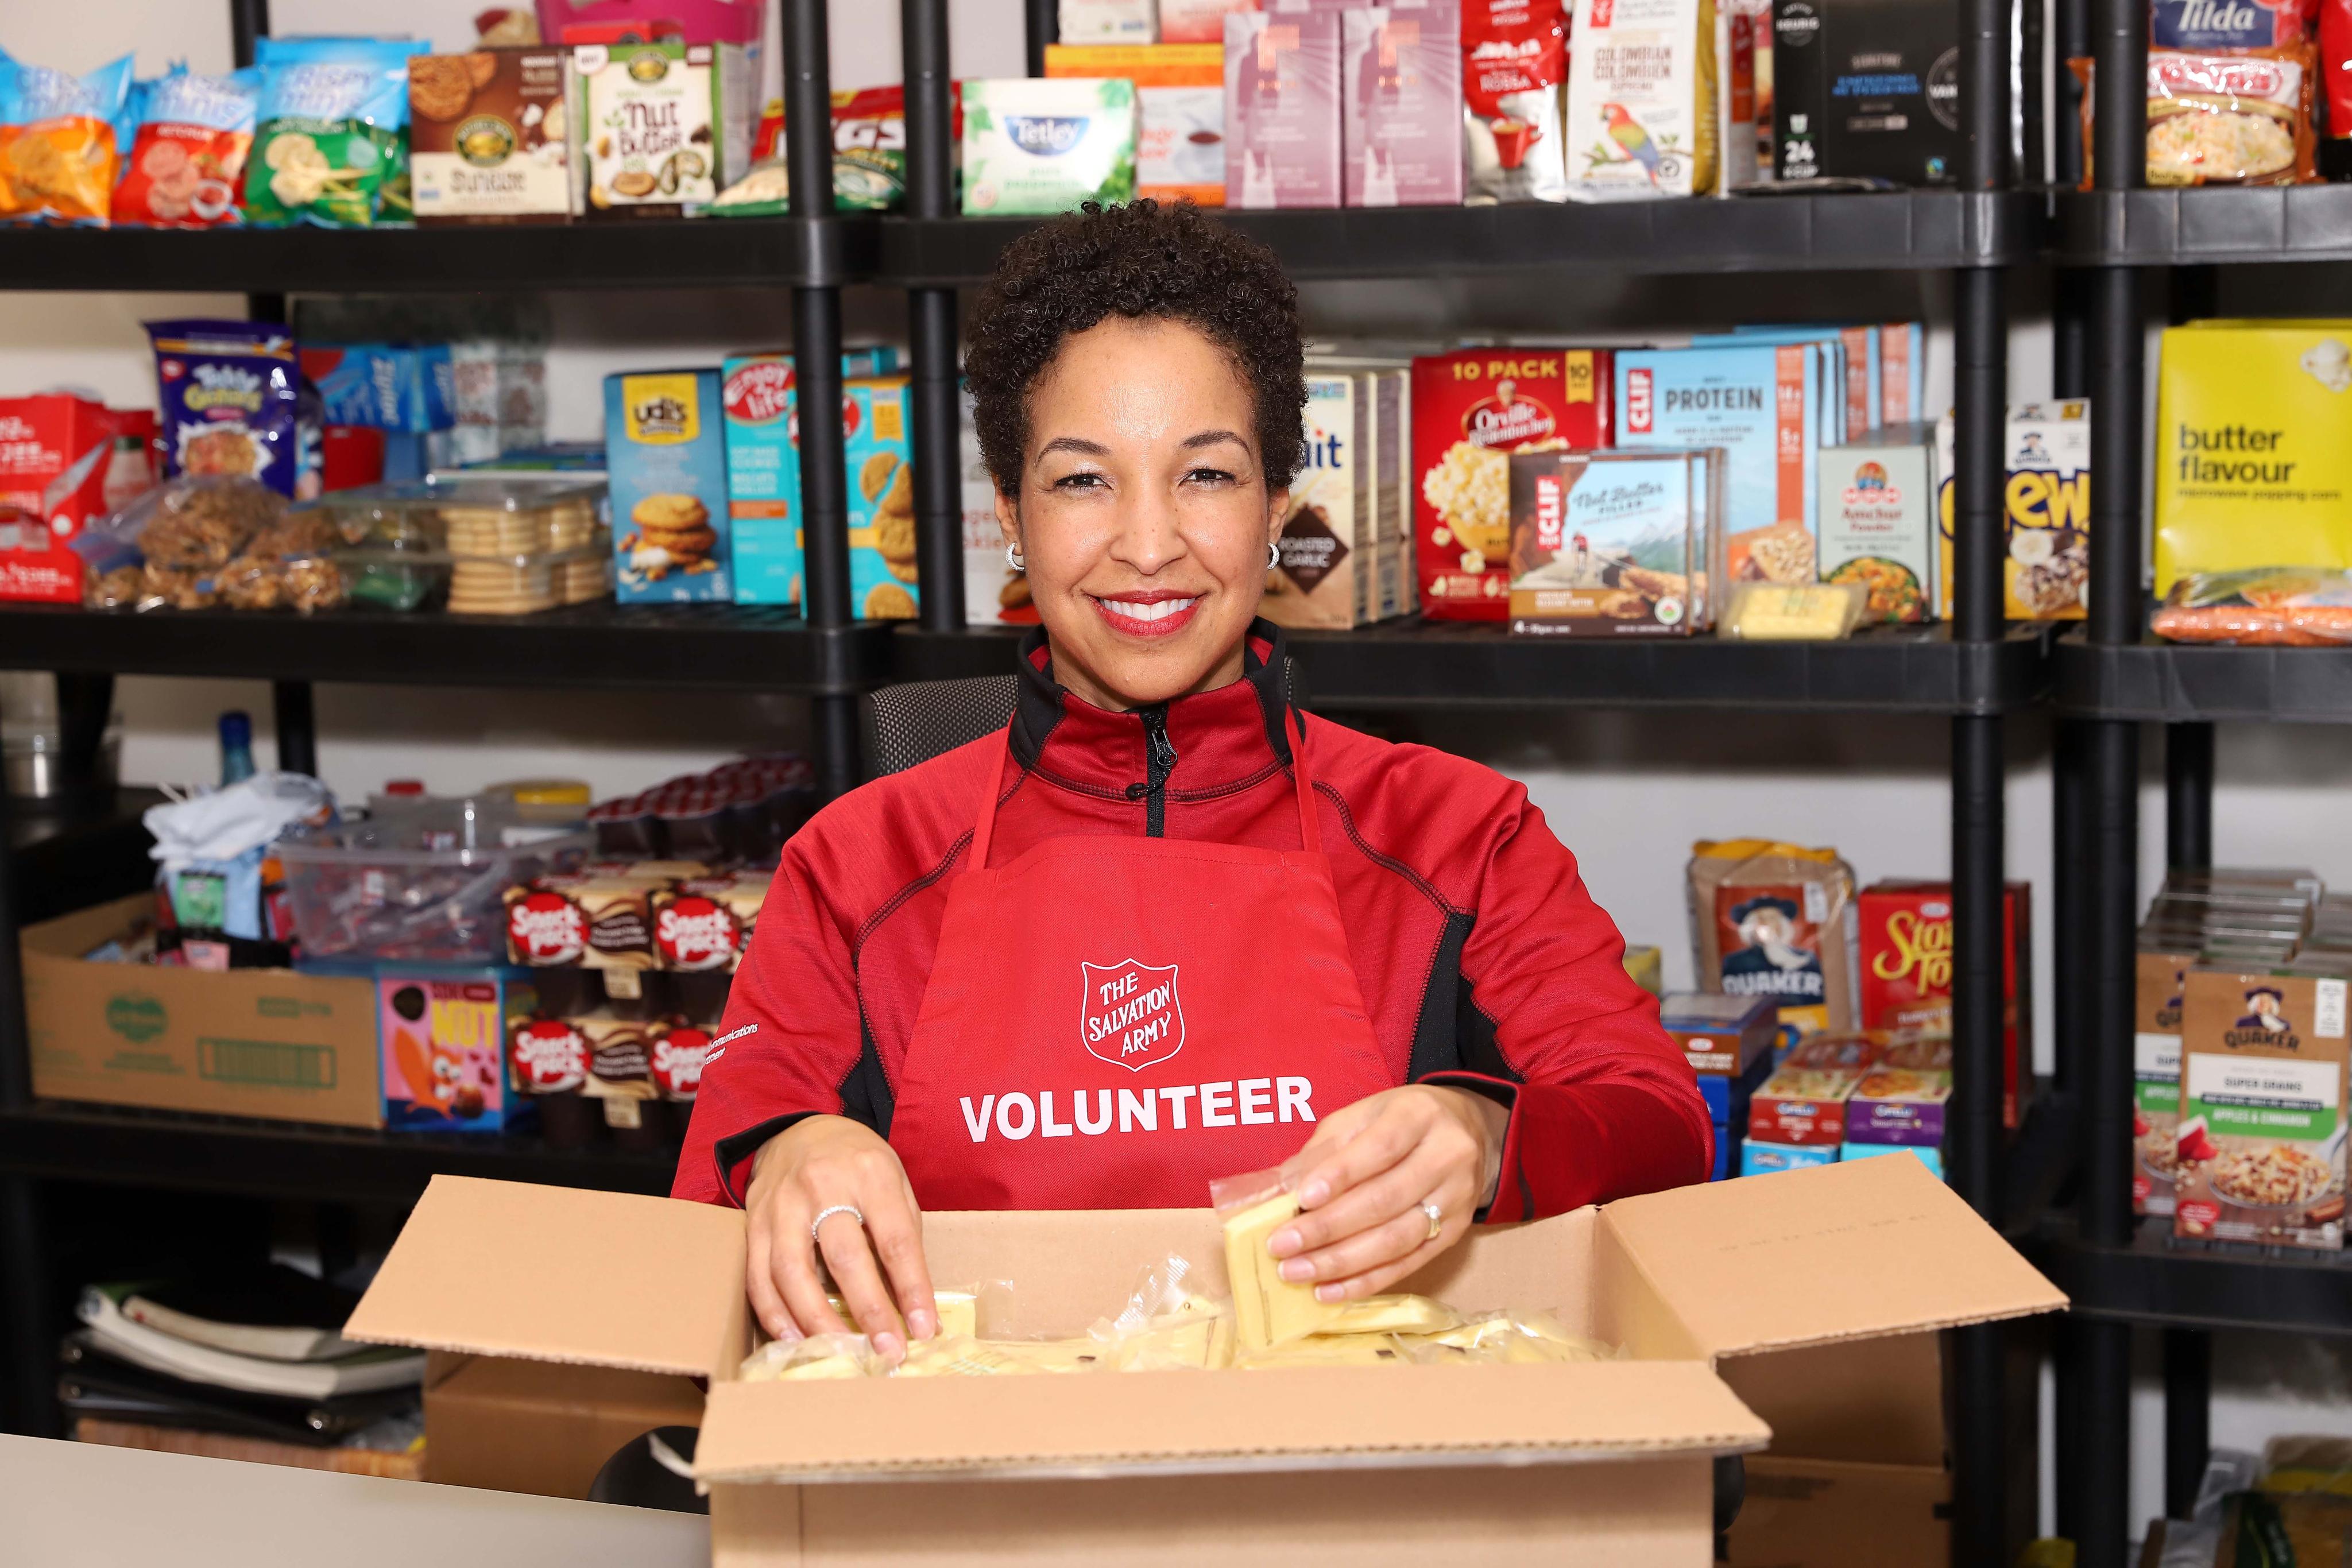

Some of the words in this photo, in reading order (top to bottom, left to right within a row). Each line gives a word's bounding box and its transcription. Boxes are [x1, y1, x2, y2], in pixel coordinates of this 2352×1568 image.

[1012, 118, 1081, 150] Tetley
[1785, 140, 1815, 163] 24
[1453, 361, 1481, 380] 10
[1487, 359, 1558, 380] PACK
[1570, 365, 1589, 379] 10
[1629, 371, 1651, 428] CLIF
[1665, 387, 1763, 412] PROTEIN
[2180, 424, 2284, 451] butter
[2180, 456, 2297, 483] flavour
[1538, 479, 1560, 535] CLIF
[512, 904, 582, 935] Snack
[659, 909, 732, 942] Snack
[1100, 971, 1139, 1006] THE
[1722, 970, 1822, 994] QUAKER
[1912, 950, 1952, 996] To
[1089, 980, 1171, 1042] SALVATION
[516, 1031, 584, 1063] Snack
[1120, 1011, 1173, 1058] ARMY
[2224, 1031, 2300, 1050] QUAKER
[959, 1075, 1317, 1143] VOLUNTEER
